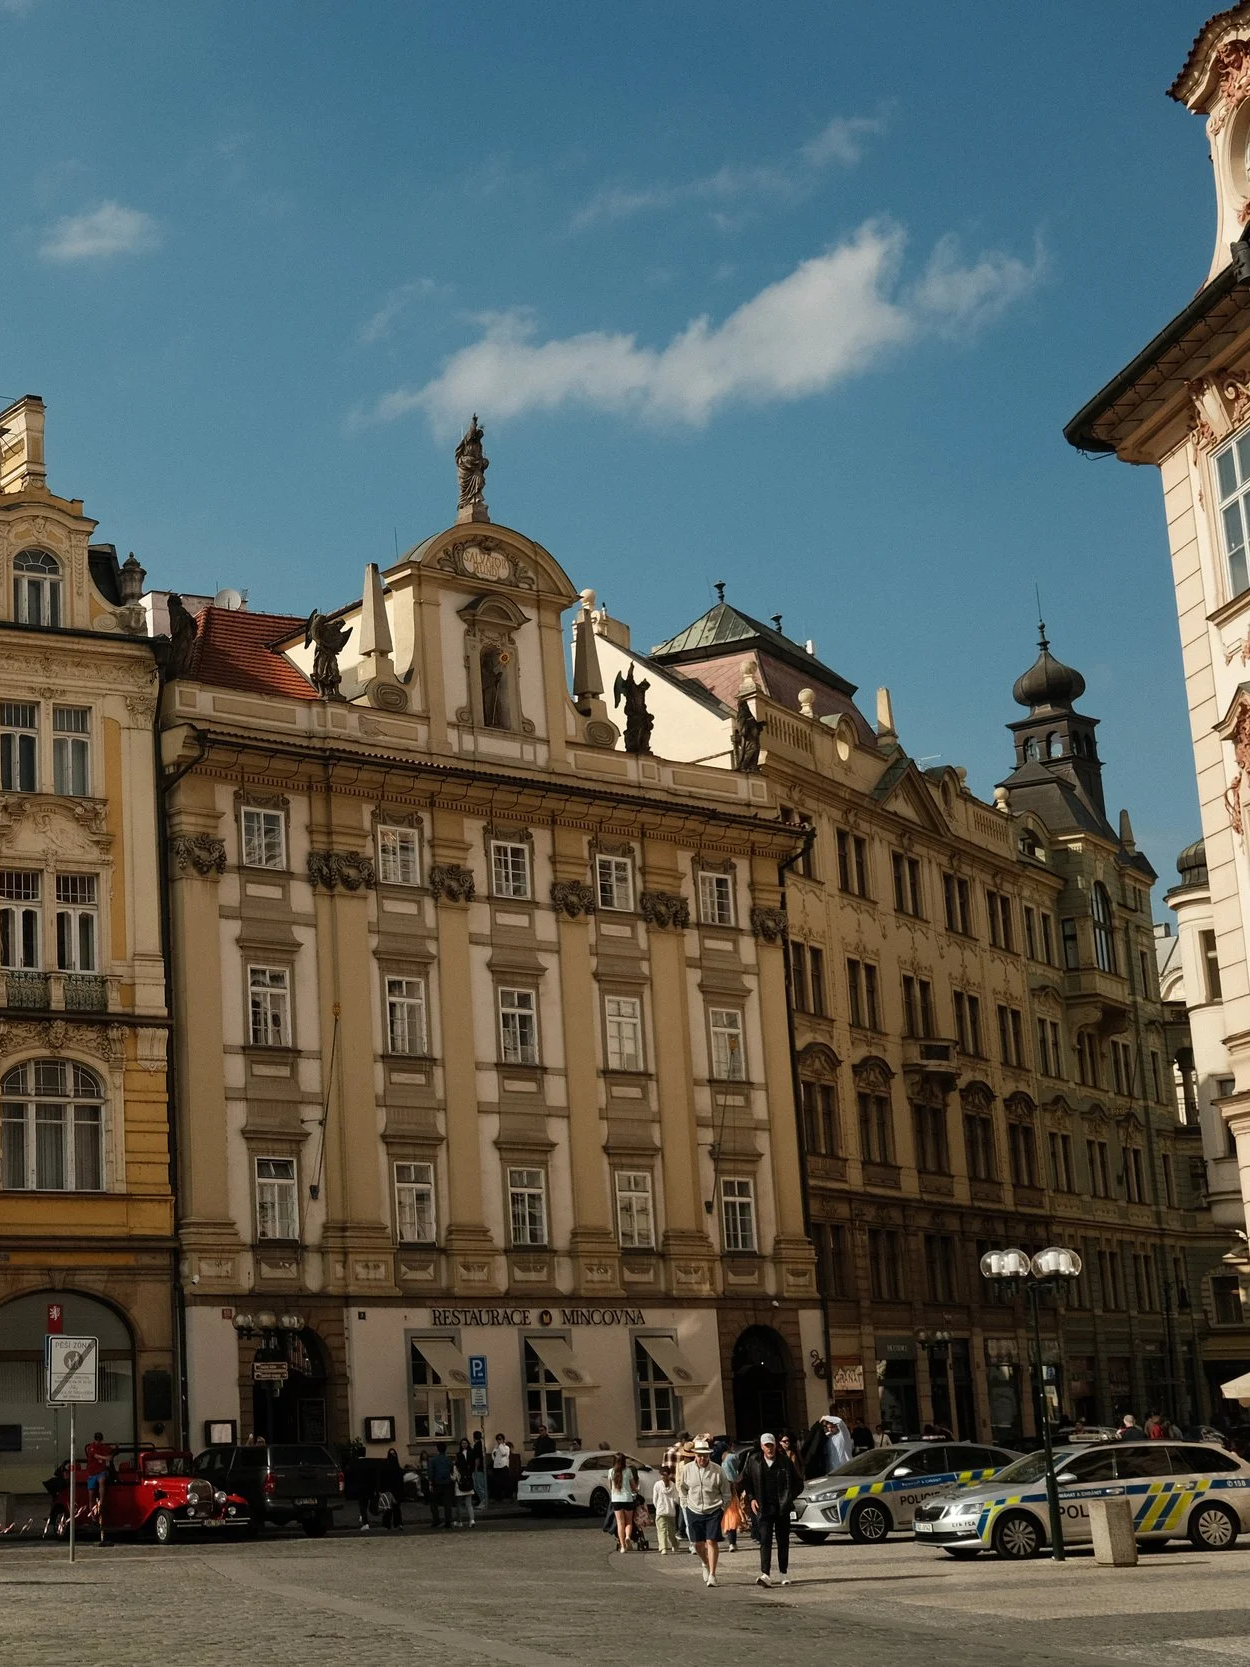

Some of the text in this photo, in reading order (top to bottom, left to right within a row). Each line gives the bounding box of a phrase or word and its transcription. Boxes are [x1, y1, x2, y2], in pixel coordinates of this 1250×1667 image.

[433, 1309, 531, 1326] RESTAURACE
[561, 1309, 646, 1325] MINCOVNA
[472, 1359, 483, 1377] P
[900, 1491, 940, 1505] POLI
